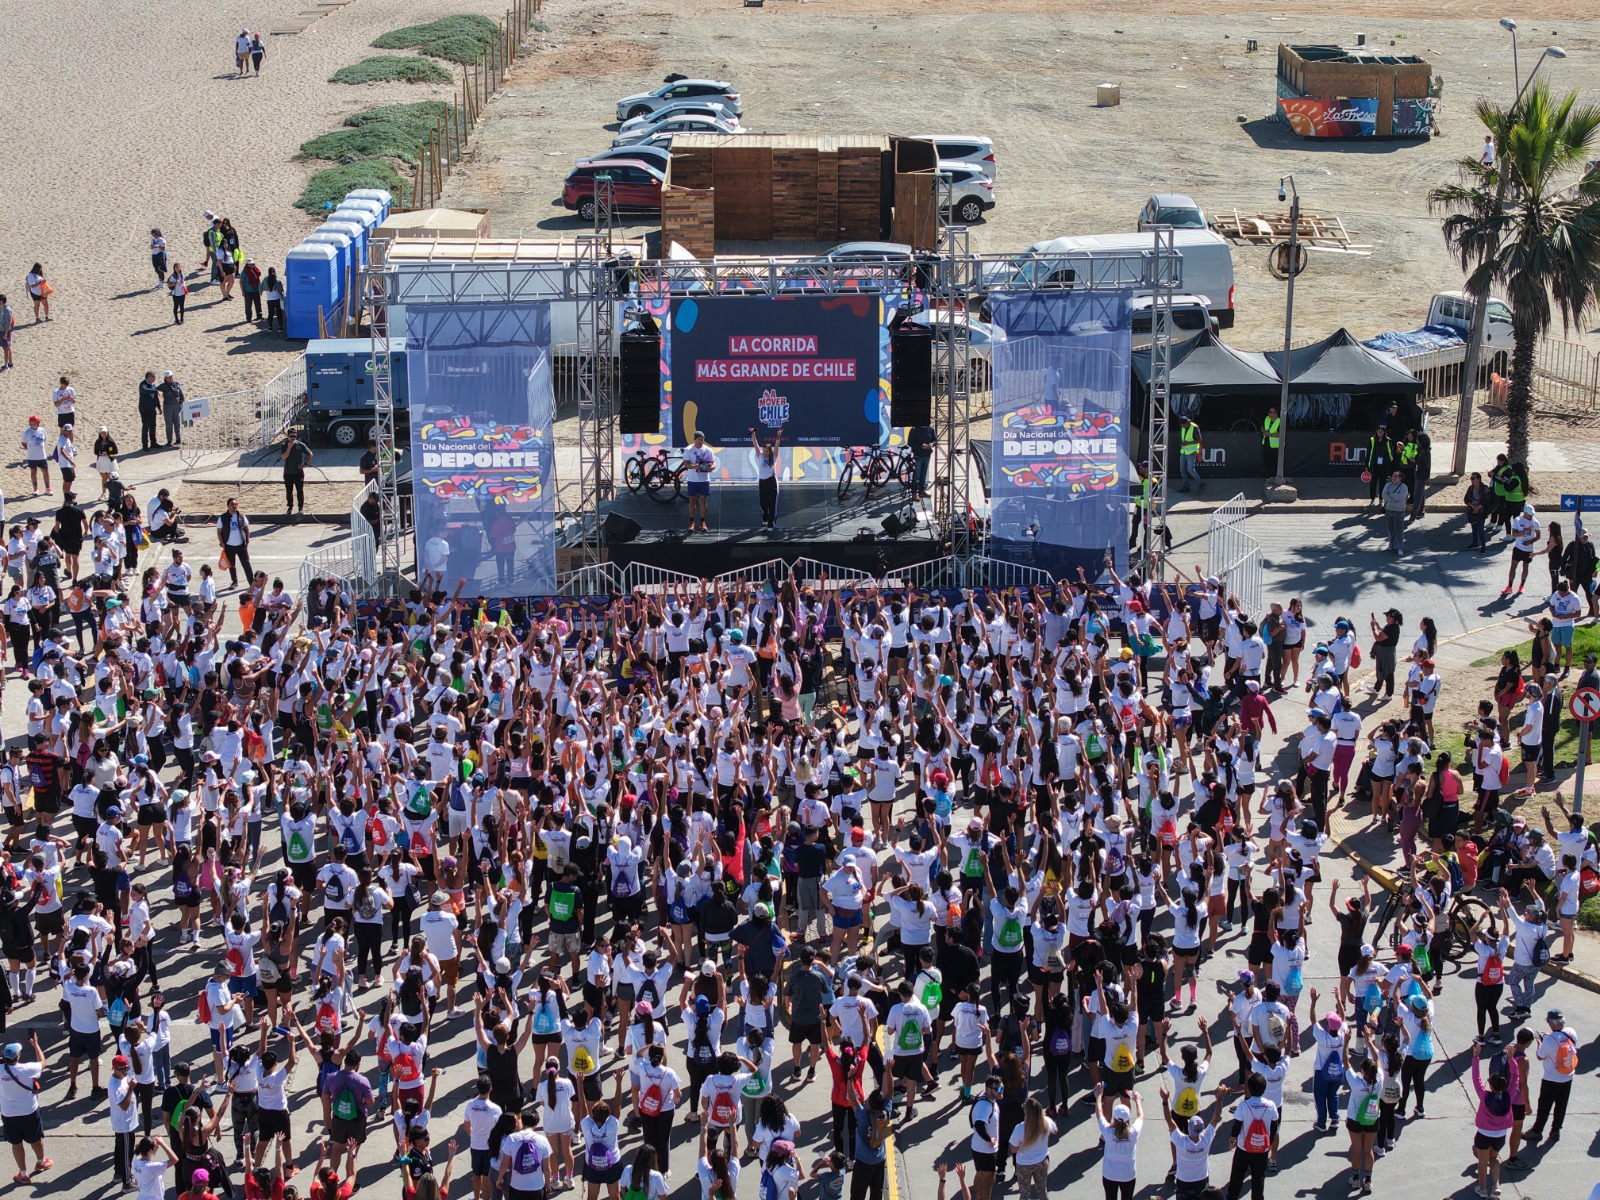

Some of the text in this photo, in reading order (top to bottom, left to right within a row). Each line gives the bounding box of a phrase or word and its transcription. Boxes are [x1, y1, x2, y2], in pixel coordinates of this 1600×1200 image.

[1323, 107, 1341, 121] La
[731, 338, 816, 352] LA CORRIDA
[697, 360, 855, 378] MÁS GRANDE DE CHILE
[770, 389, 777, 398] A
[759, 398, 787, 406] MOVER
[759, 404, 789, 420] CHILE
[1003, 430, 1070, 439] Día Nacional del
[422, 443, 491, 451] Día Nacional del
[1003, 439, 1118, 456] DEPORTE
[1329, 442, 1368, 462] Run
[423, 452, 540, 468] DEPORTE
